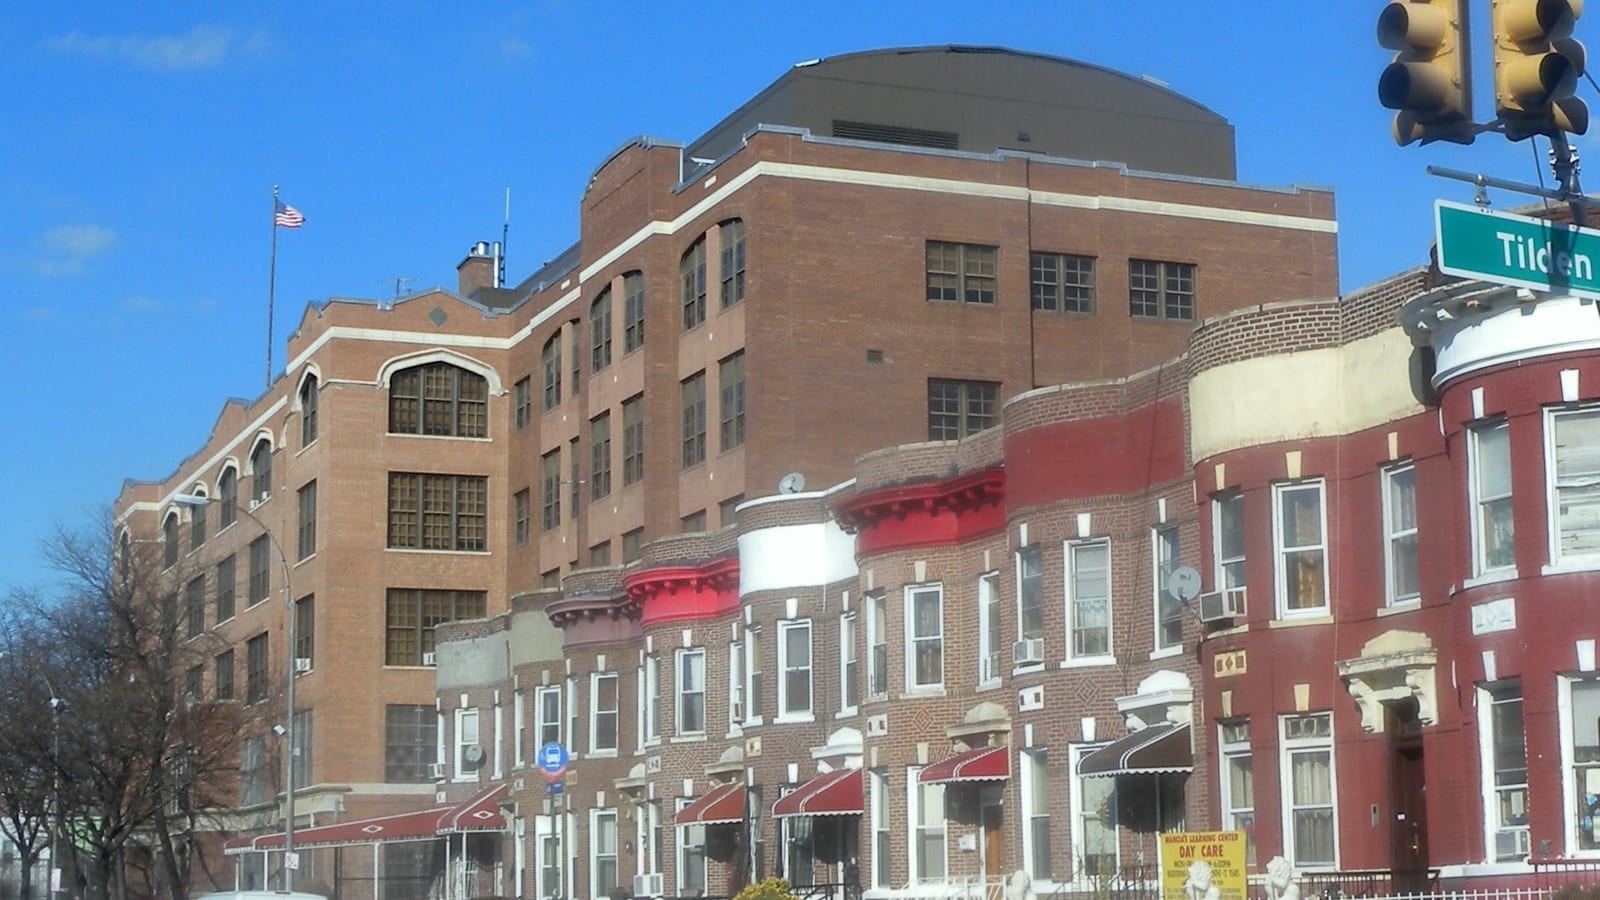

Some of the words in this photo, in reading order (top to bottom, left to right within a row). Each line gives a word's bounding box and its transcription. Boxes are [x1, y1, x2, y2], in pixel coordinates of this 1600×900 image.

[1496, 231, 1593, 281] Tilden
[1189, 833, 1216, 843] LEARNING
[1218, 833, 1238, 842] CENTER
[1179, 845, 1196, 858] DAY
[1201, 844, 1224, 858] CARE
